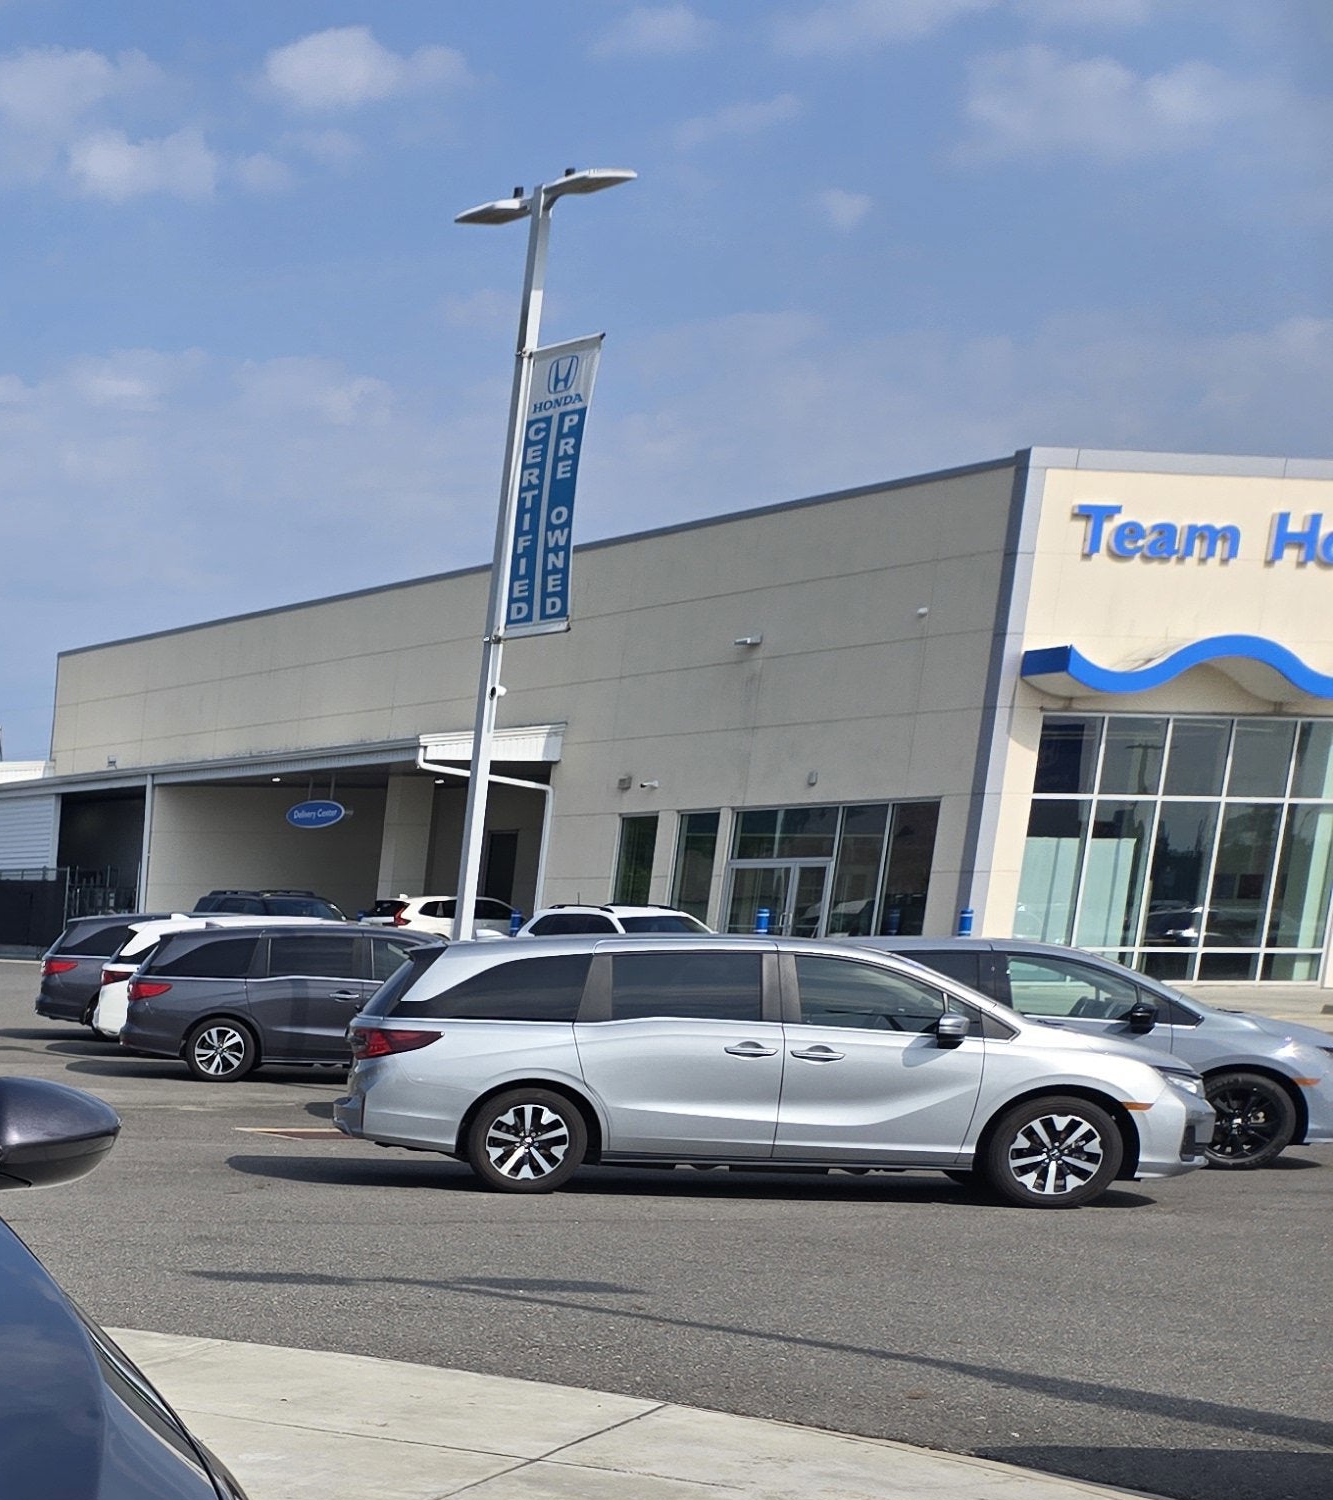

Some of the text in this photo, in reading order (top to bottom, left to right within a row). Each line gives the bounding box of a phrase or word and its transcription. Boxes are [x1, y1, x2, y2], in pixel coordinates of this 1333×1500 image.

[532, 393, 583, 414] HONDA
[510, 422, 547, 621] CERTIFIED
[545, 414, 580, 616] PRE OWNED
[1072, 503, 1241, 561] Team
[293, 808, 338, 820] Delivery Center
